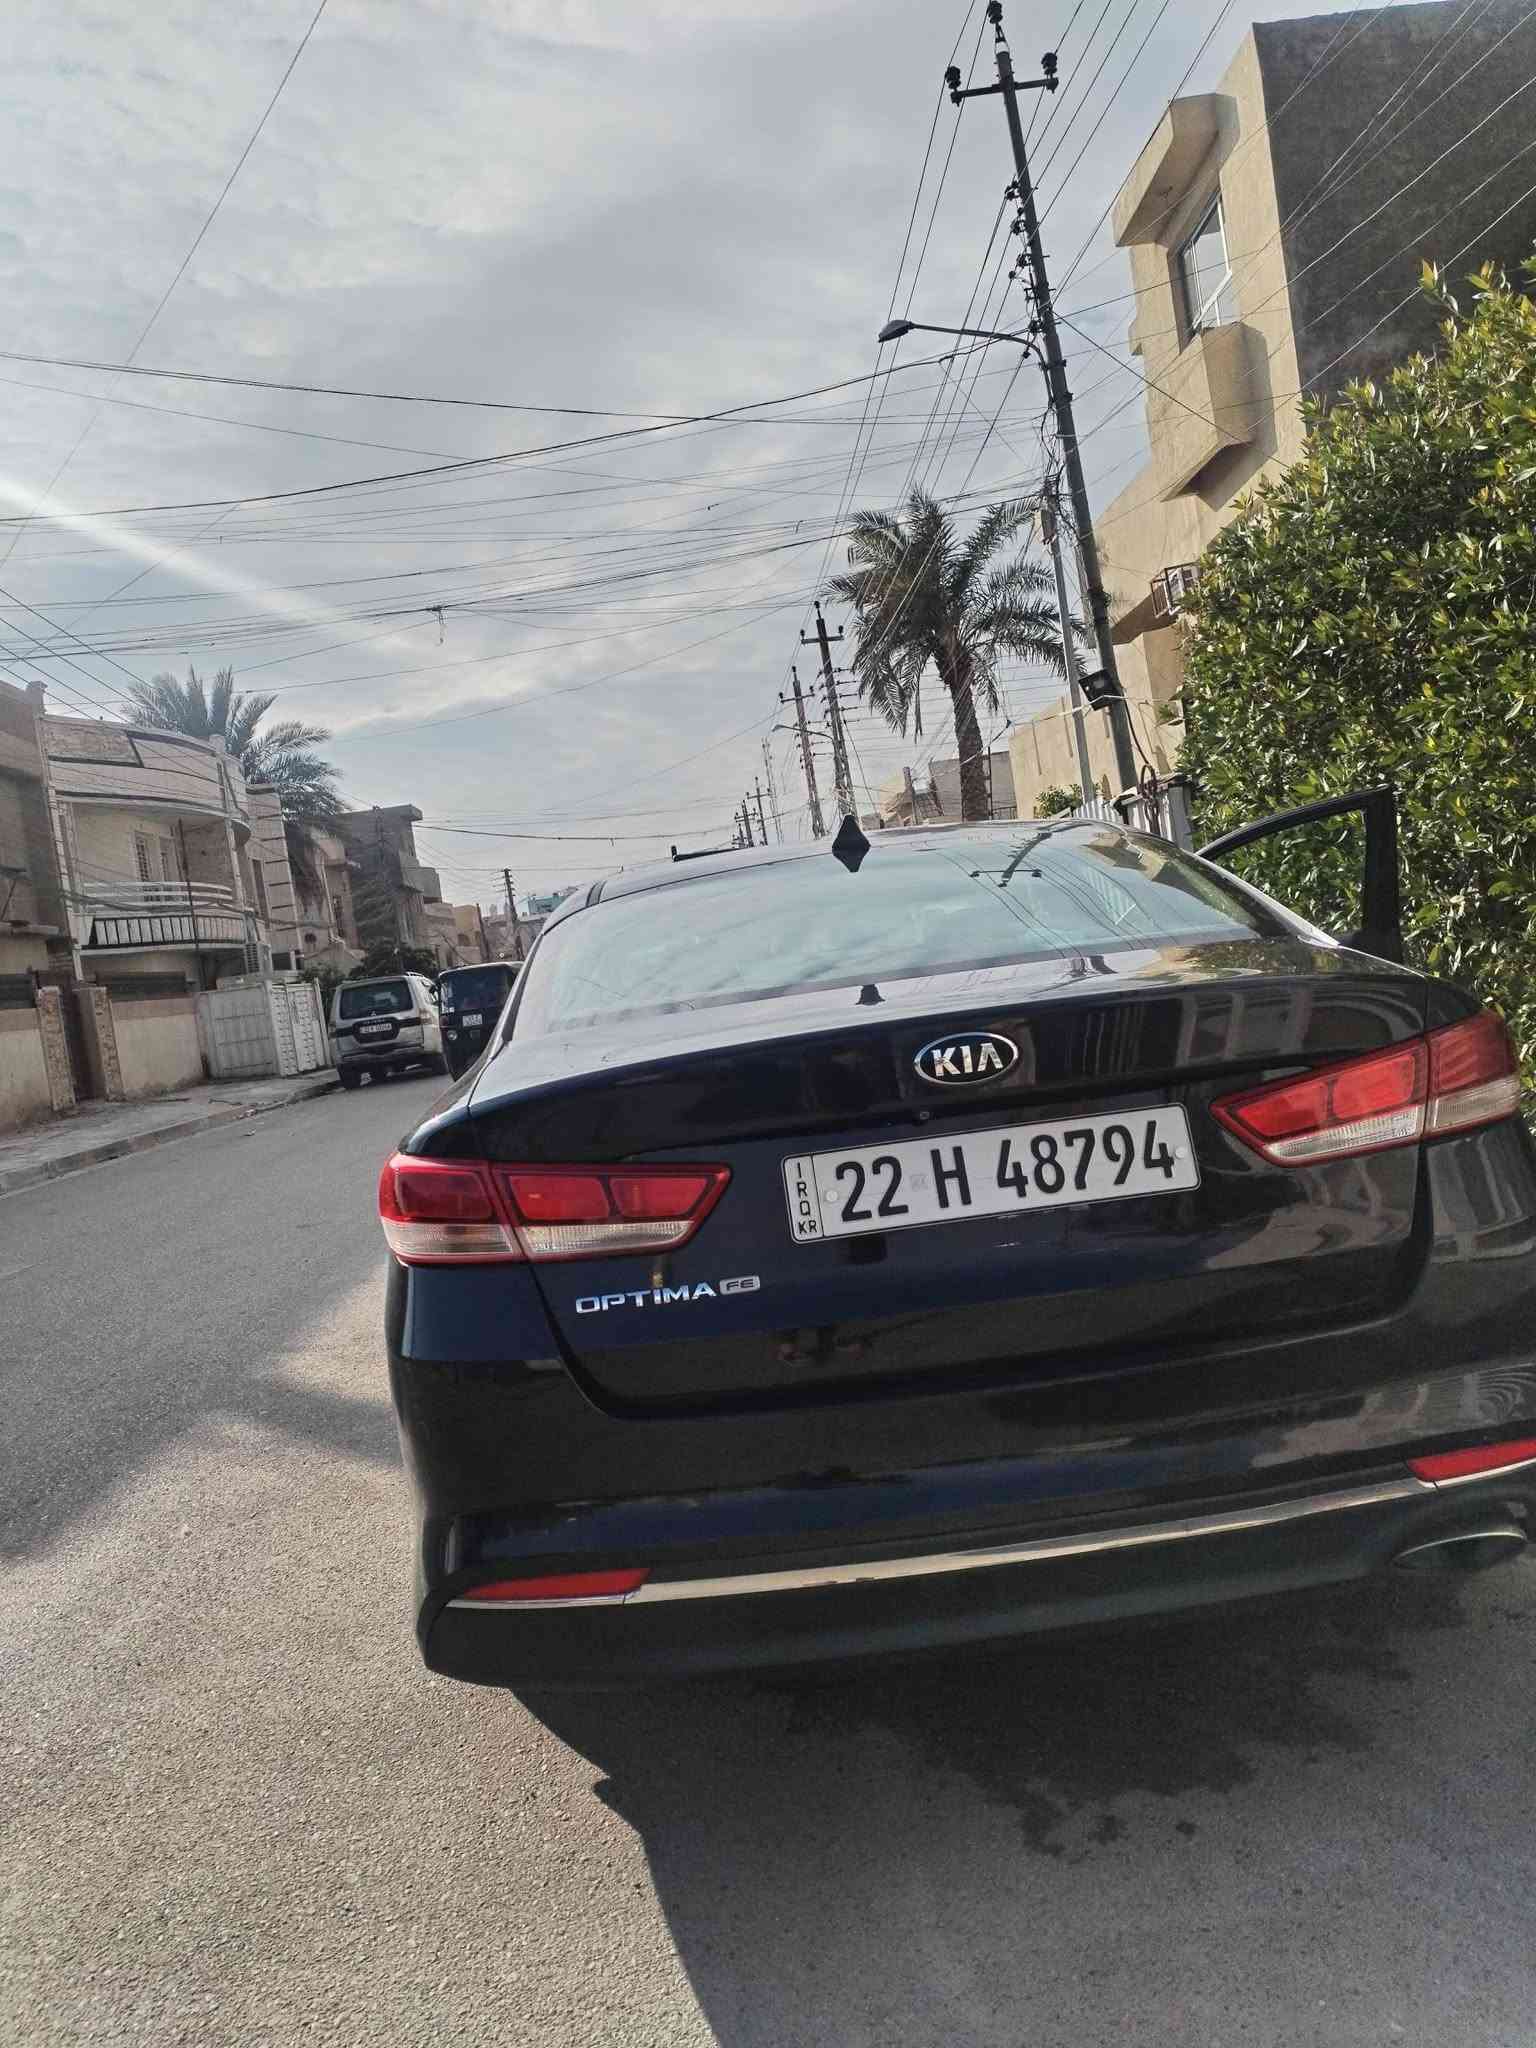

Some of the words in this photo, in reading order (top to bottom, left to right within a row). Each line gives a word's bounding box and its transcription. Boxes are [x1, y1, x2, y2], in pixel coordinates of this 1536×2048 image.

[929, 1042, 1005, 1077] KIA
[834, 1155, 910, 1223] 22
[929, 1145, 973, 1209] H
[995, 1119, 1176, 1199] 48794
[798, 1219, 818, 1235] KR
[575, 1281, 717, 1314] OPTIMA
[724, 1277, 757, 1293] FE
